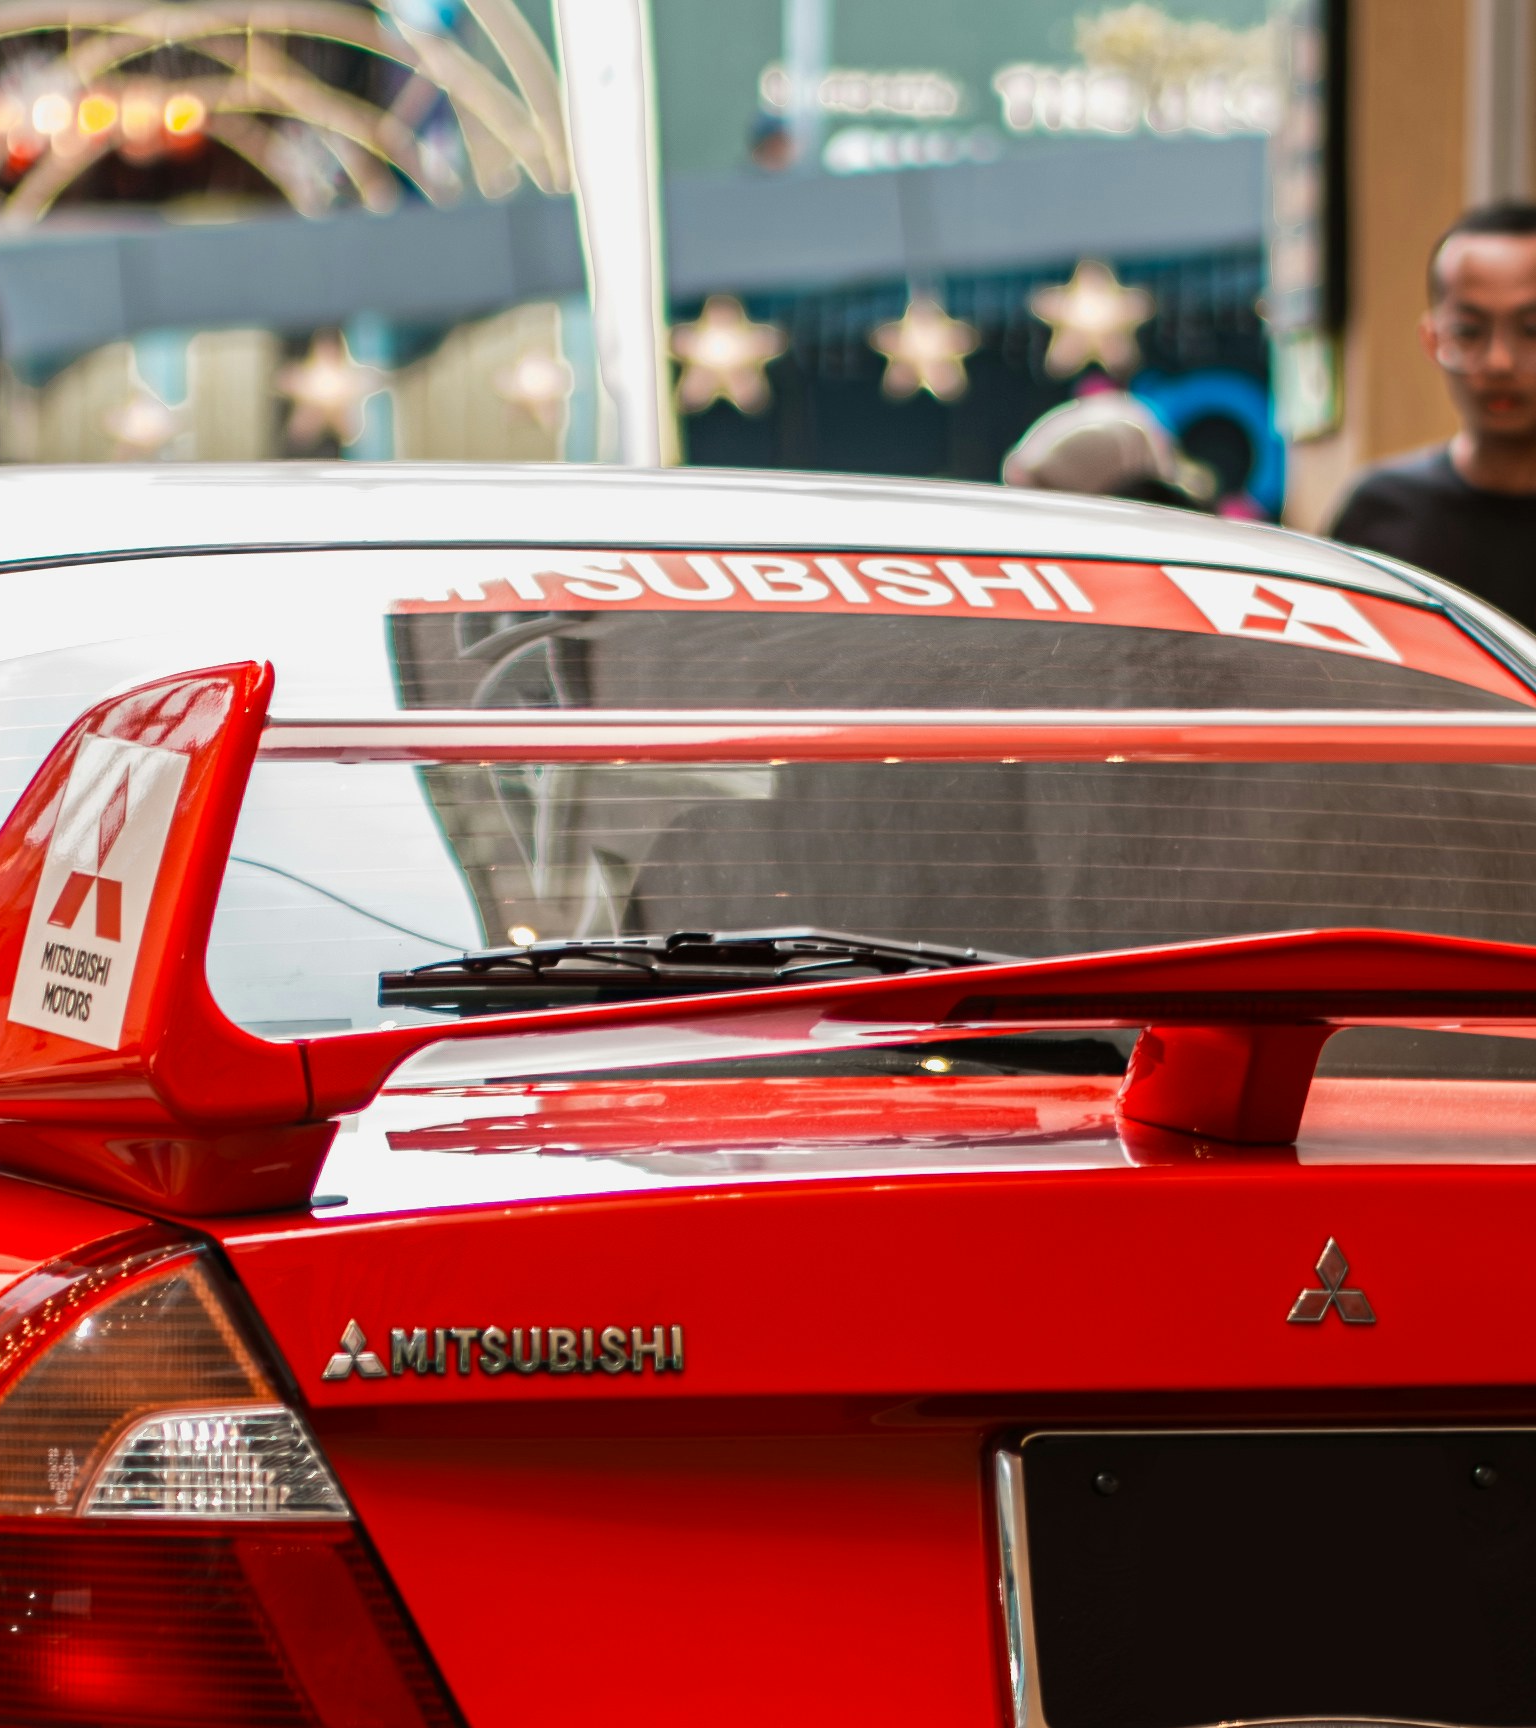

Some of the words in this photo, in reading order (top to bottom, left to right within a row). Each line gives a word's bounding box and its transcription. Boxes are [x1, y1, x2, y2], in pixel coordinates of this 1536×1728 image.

[41, 941, 112, 987] MITSUBISHI
[42, 984, 93, 1022] MOTORS
[390, 1324, 685, 1376] MITSUBISHI
